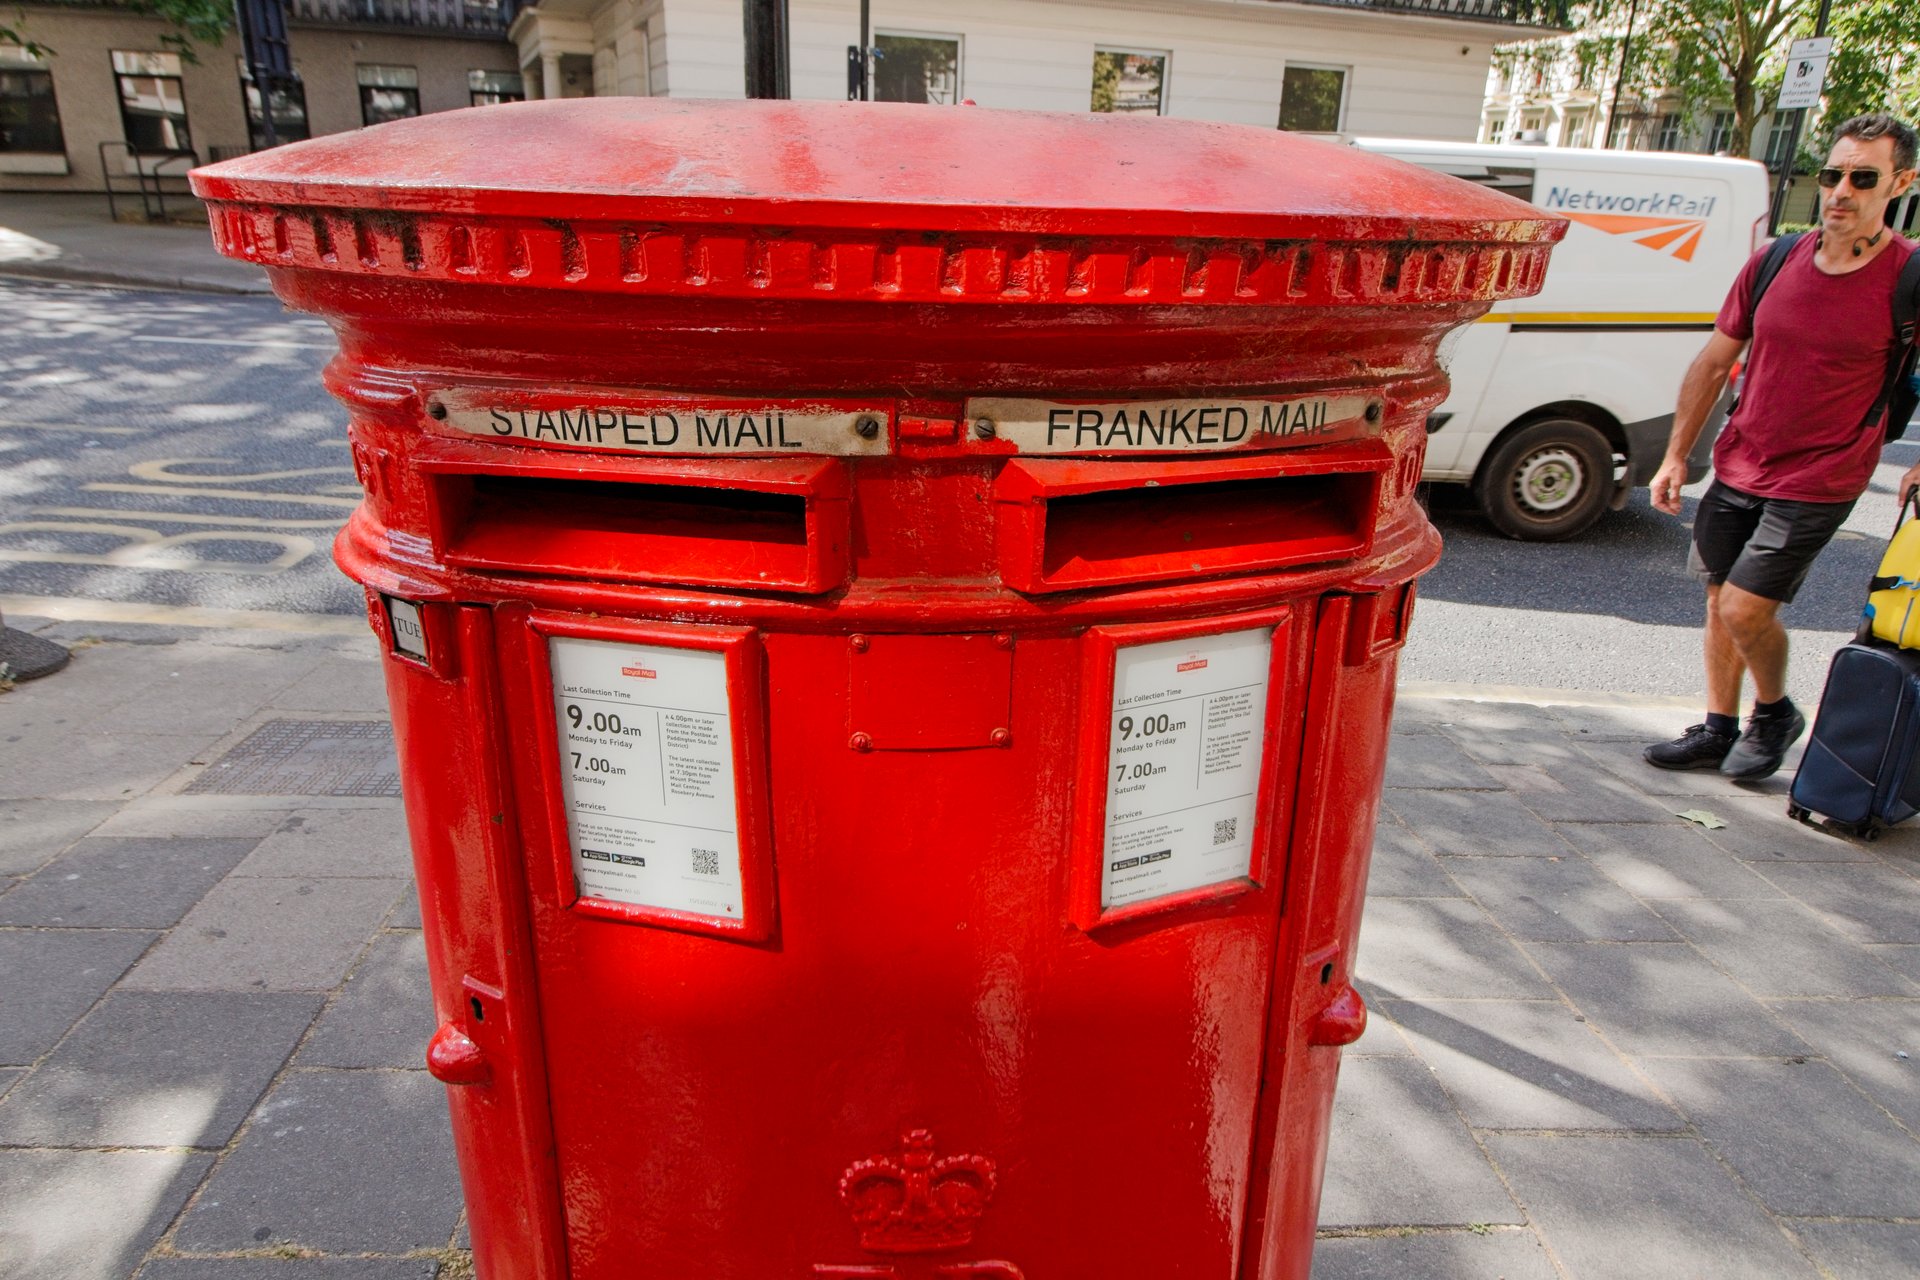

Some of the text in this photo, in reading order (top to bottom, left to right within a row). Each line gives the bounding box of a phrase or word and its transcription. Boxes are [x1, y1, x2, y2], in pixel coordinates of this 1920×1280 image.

[490, 407, 803, 449] STAMPED MAIL
[1047, 401, 1336, 446] FRANKED MAIL
[394, 616, 422, 640] TUE
[623, 668, 641, 676] Royal
[563, 684, 631, 699] Last Collection Time
[1118, 698, 1132, 706] Last
[1134, 692, 1165, 702] Collection
[567, 704, 641, 736] 9.00am
[1118, 714, 1186, 741] 9.00am
[568, 733, 597, 745] Monday
[609, 738, 633, 749] Friday
[1116, 744, 1144, 755] Monday
[1155, 738, 1176, 746] Friday
[570, 752, 626, 775] 7.00am
[572, 774, 606, 786] Saturday
[1116, 762, 1166, 782] 7.00am
[1114, 784, 1146, 796] Saturday
[575, 800, 606, 811] Services
[1113, 811, 1142, 822] Services
